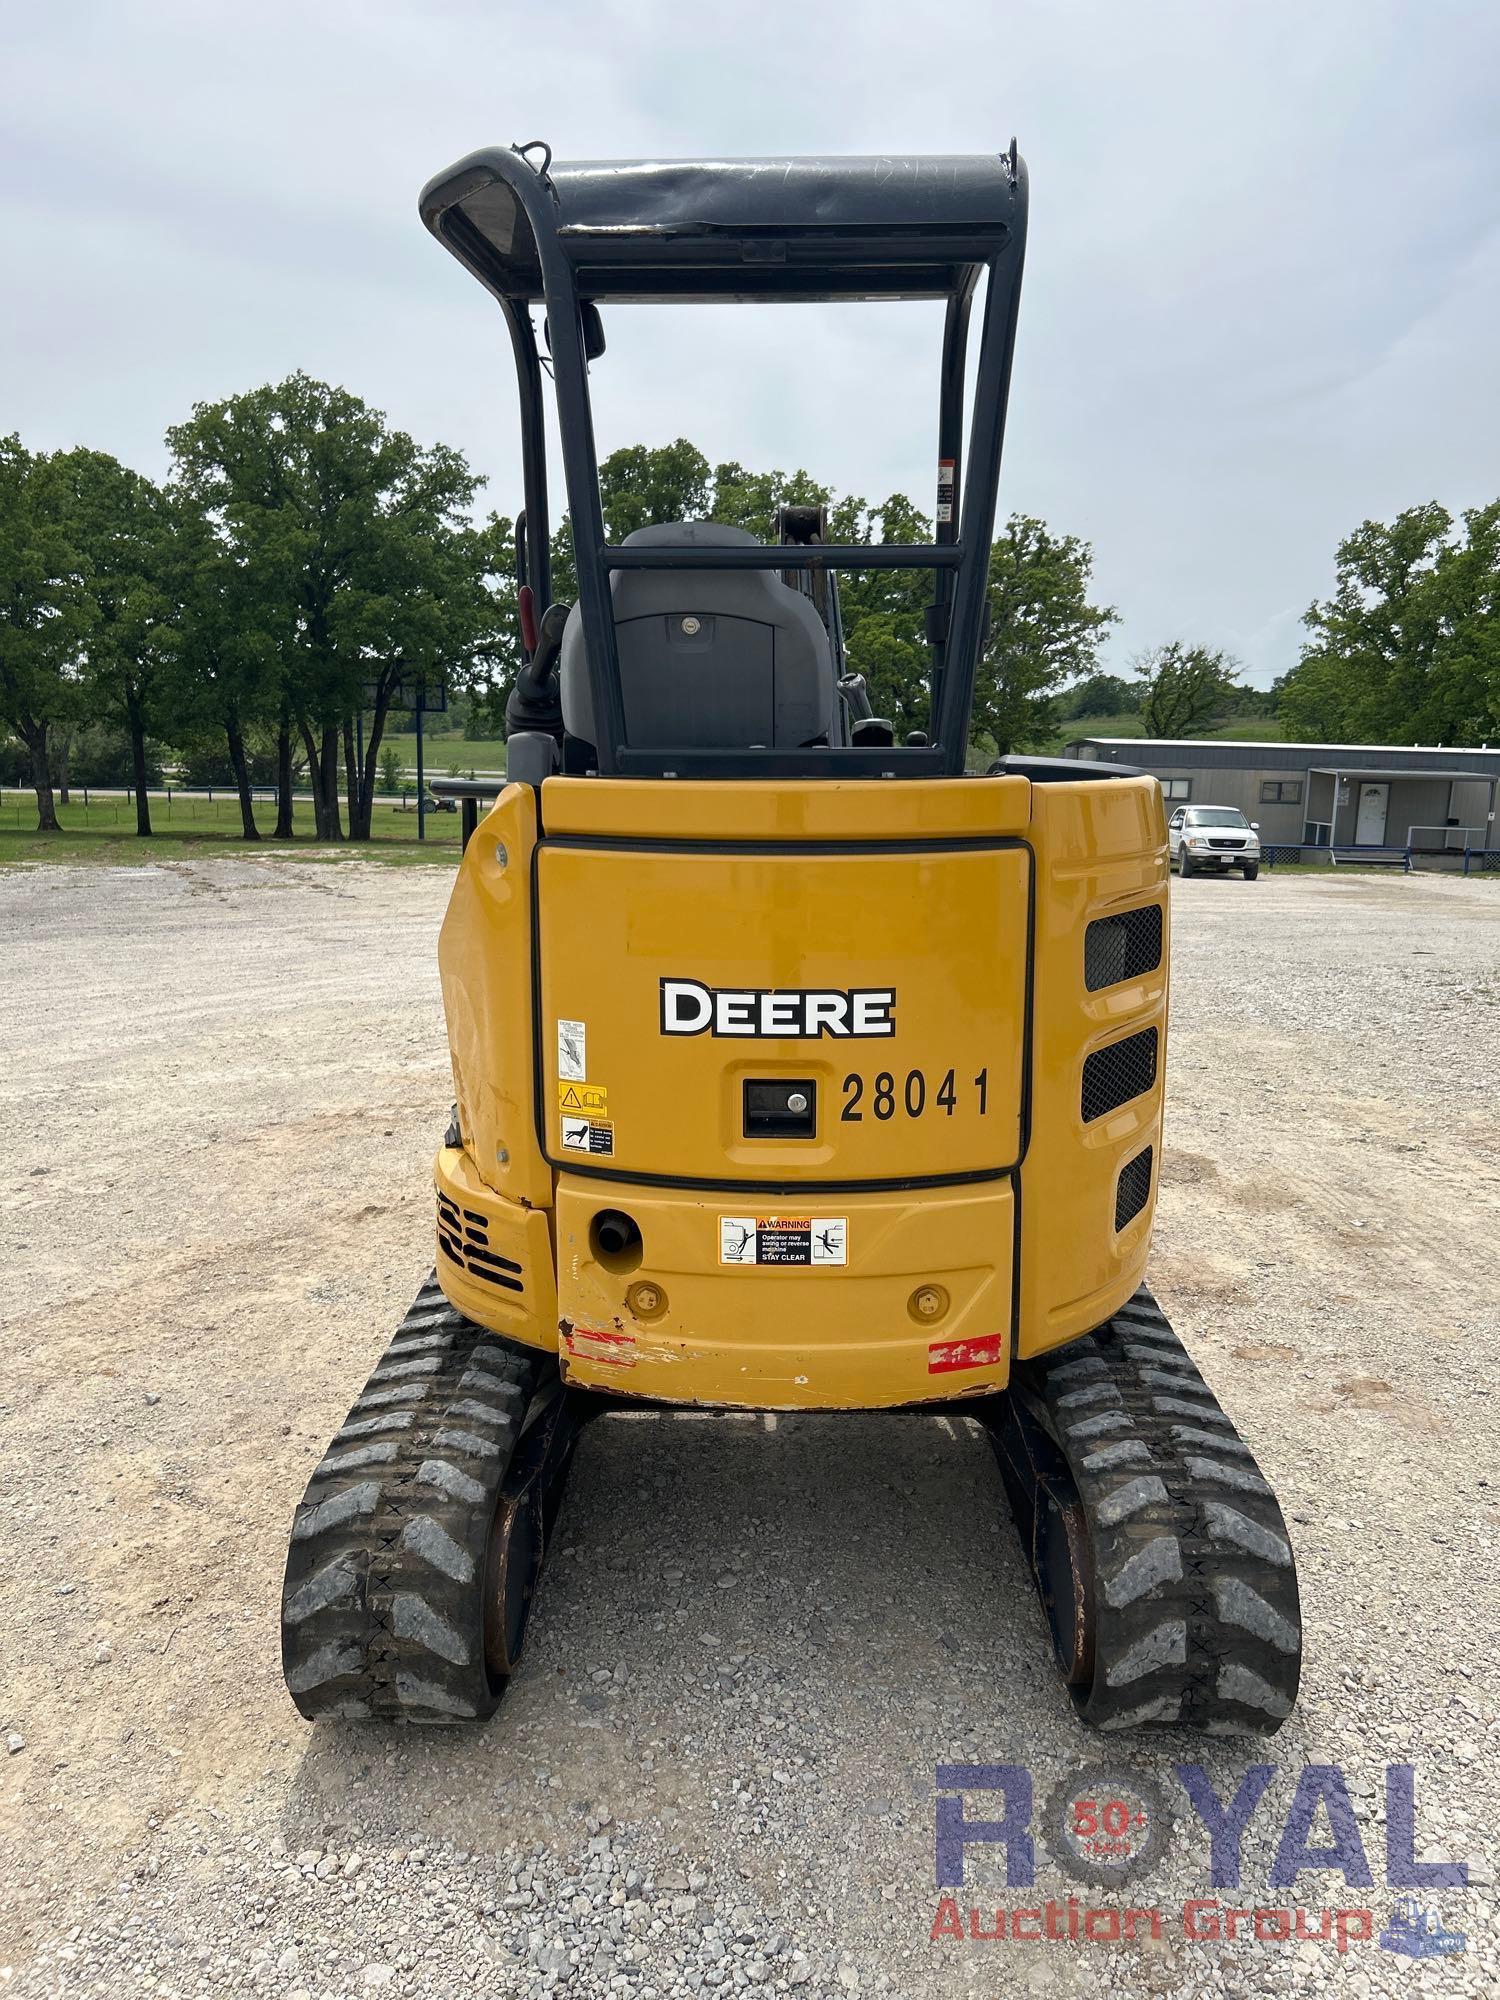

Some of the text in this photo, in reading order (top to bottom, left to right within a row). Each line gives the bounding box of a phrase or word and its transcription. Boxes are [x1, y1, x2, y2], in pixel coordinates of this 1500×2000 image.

[661, 980, 893, 1037] DEERE
[840, 1067, 988, 1121] 28041
[767, 1220, 810, 1229] WARNING
